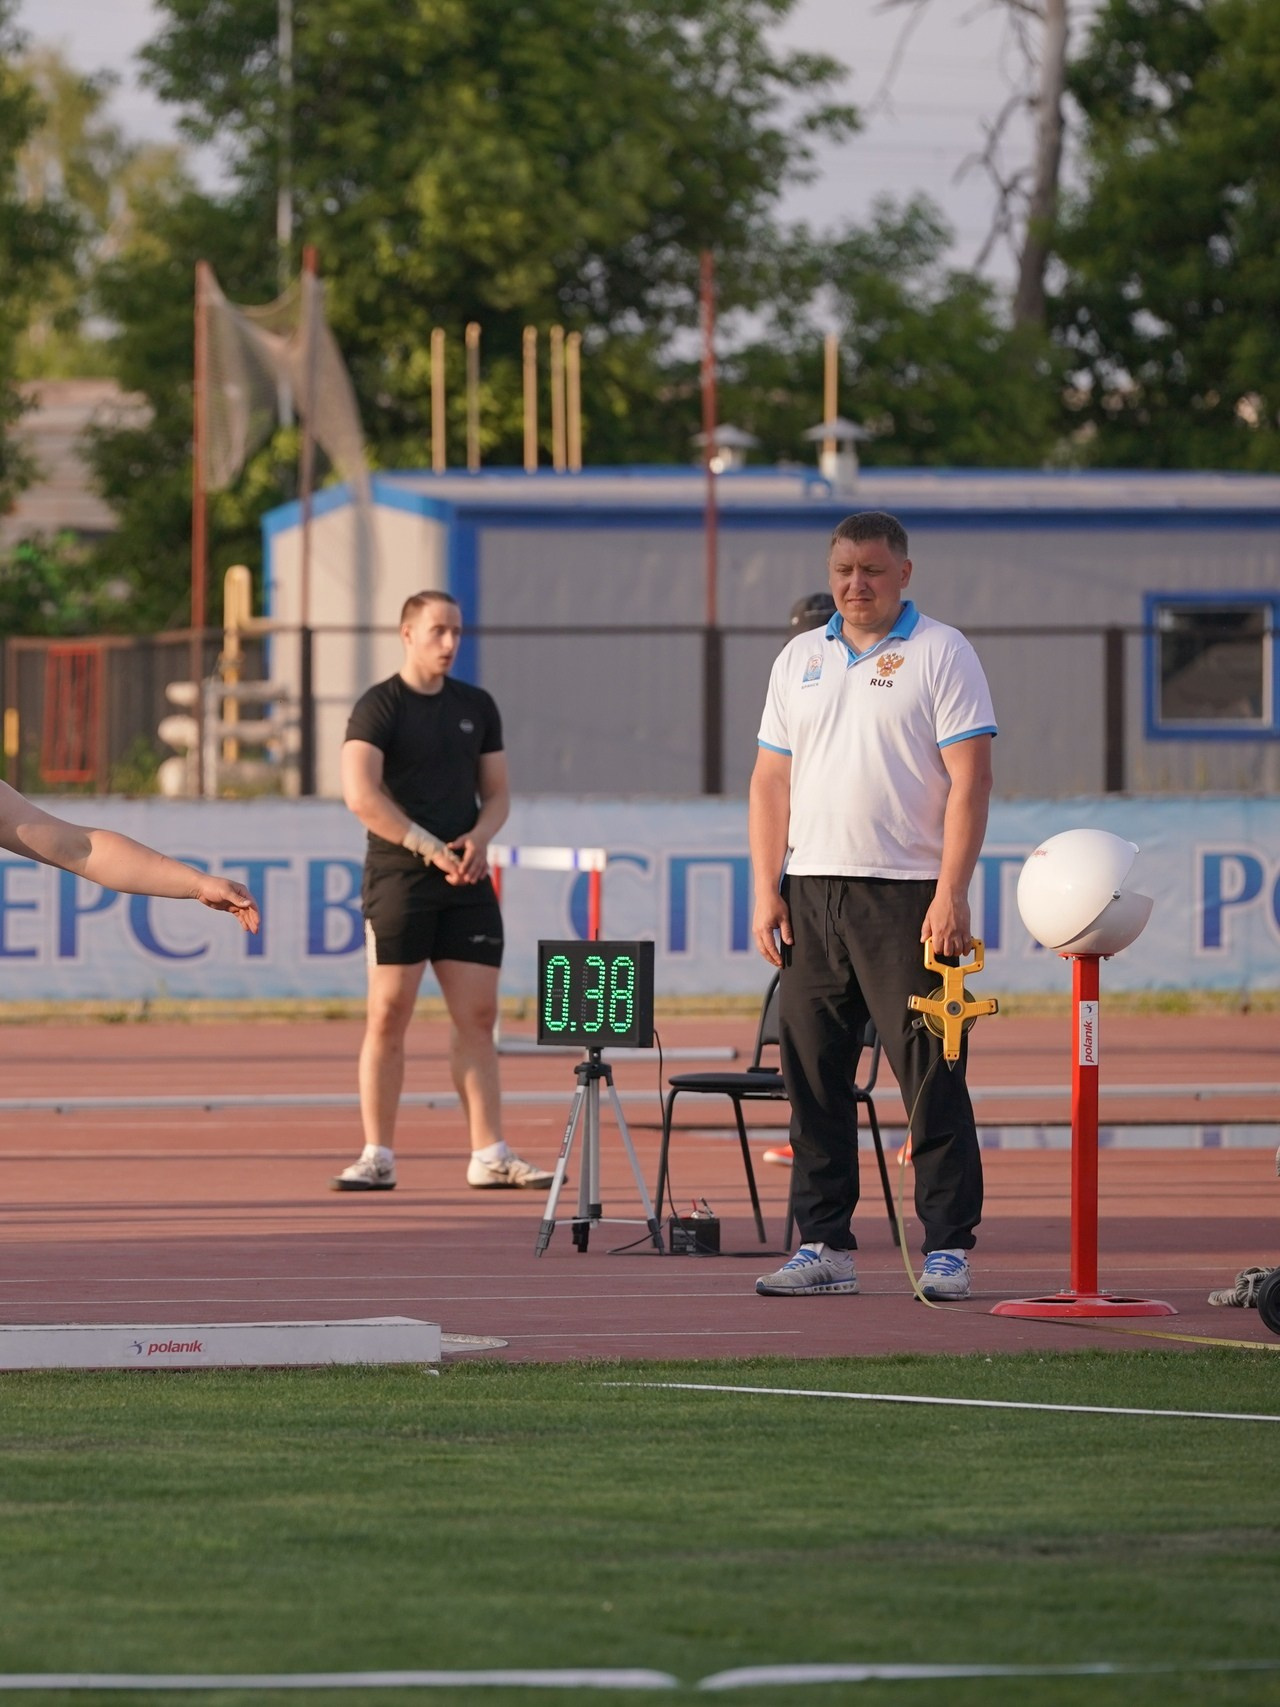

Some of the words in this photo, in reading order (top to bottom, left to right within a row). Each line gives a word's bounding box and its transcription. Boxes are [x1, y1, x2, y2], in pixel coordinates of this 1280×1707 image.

[869, 678, 894, 688] RUS
[545, 955, 634, 1033] 0.38
[1083, 1020, 1094, 1063] polanik
[147, 1340, 203, 1356] polanik
